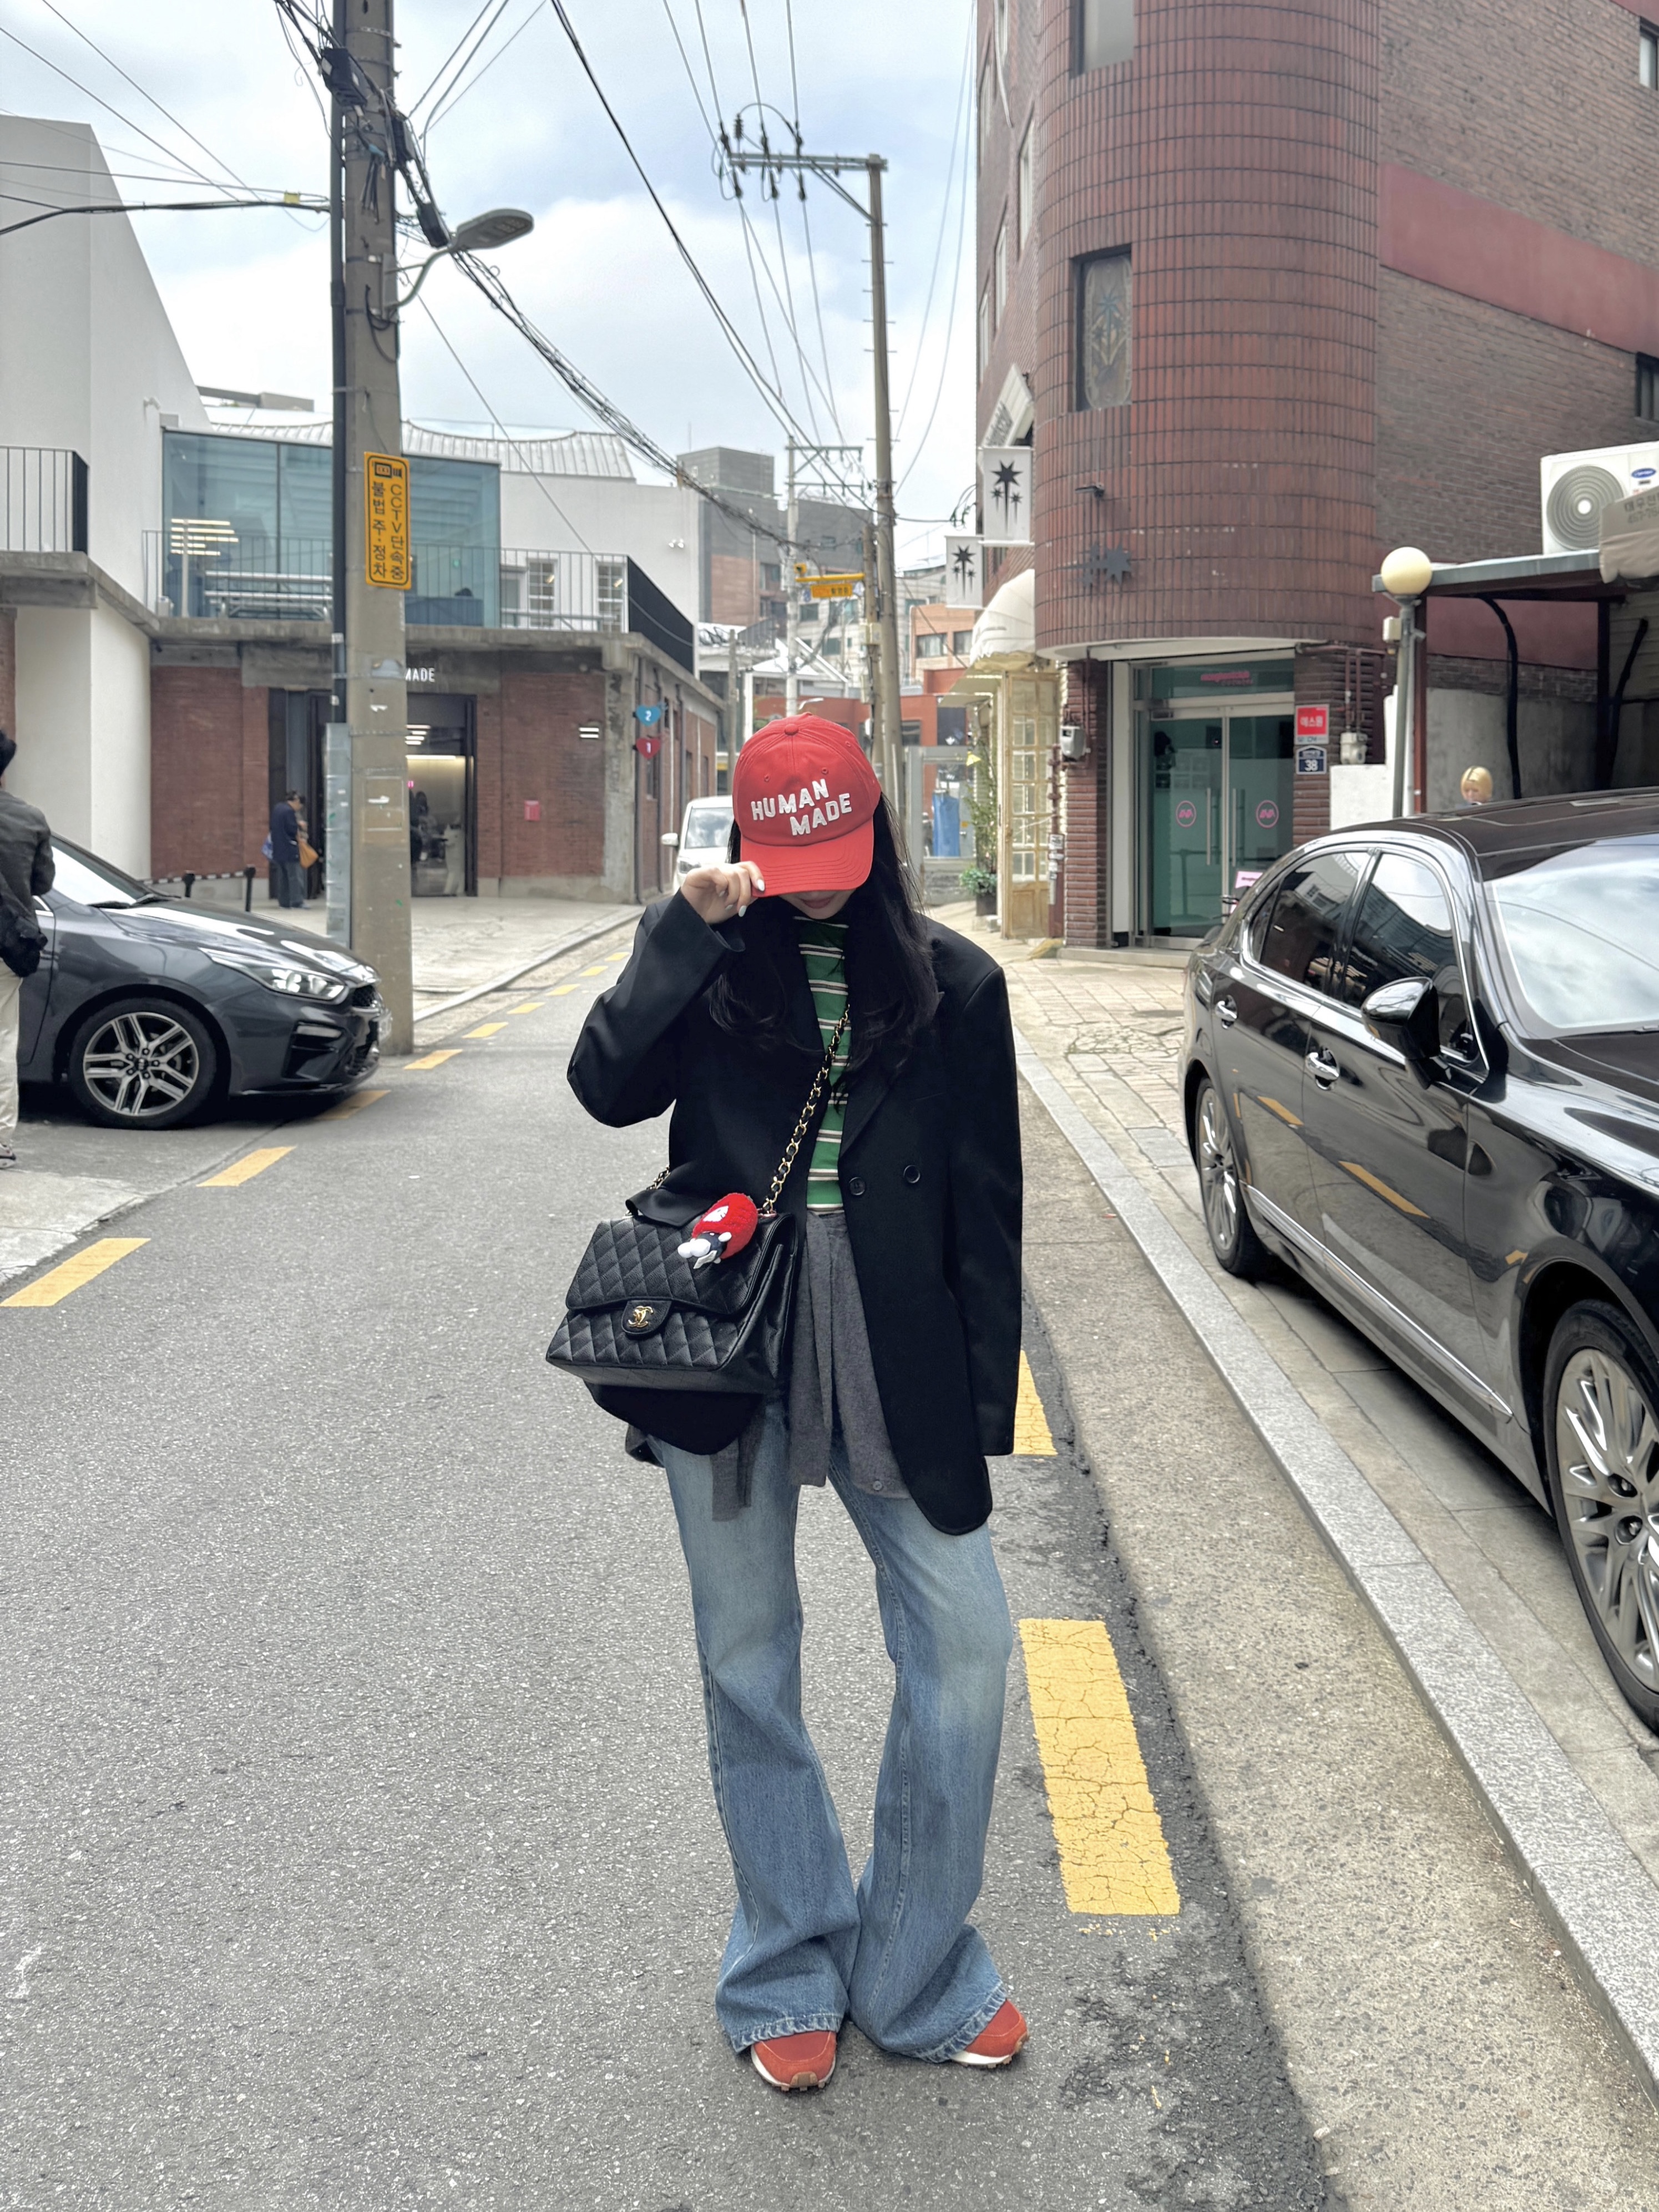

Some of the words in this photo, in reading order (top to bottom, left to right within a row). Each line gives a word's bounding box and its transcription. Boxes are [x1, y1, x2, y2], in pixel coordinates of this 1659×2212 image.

[372, 481, 386, 515] 불법
[645, 710, 652, 721] 2
[646, 742, 651, 753] 1
[1304, 760, 1318, 771] 38
[751, 778, 830, 821] HUMAN
[790, 793, 852, 836] MADE
